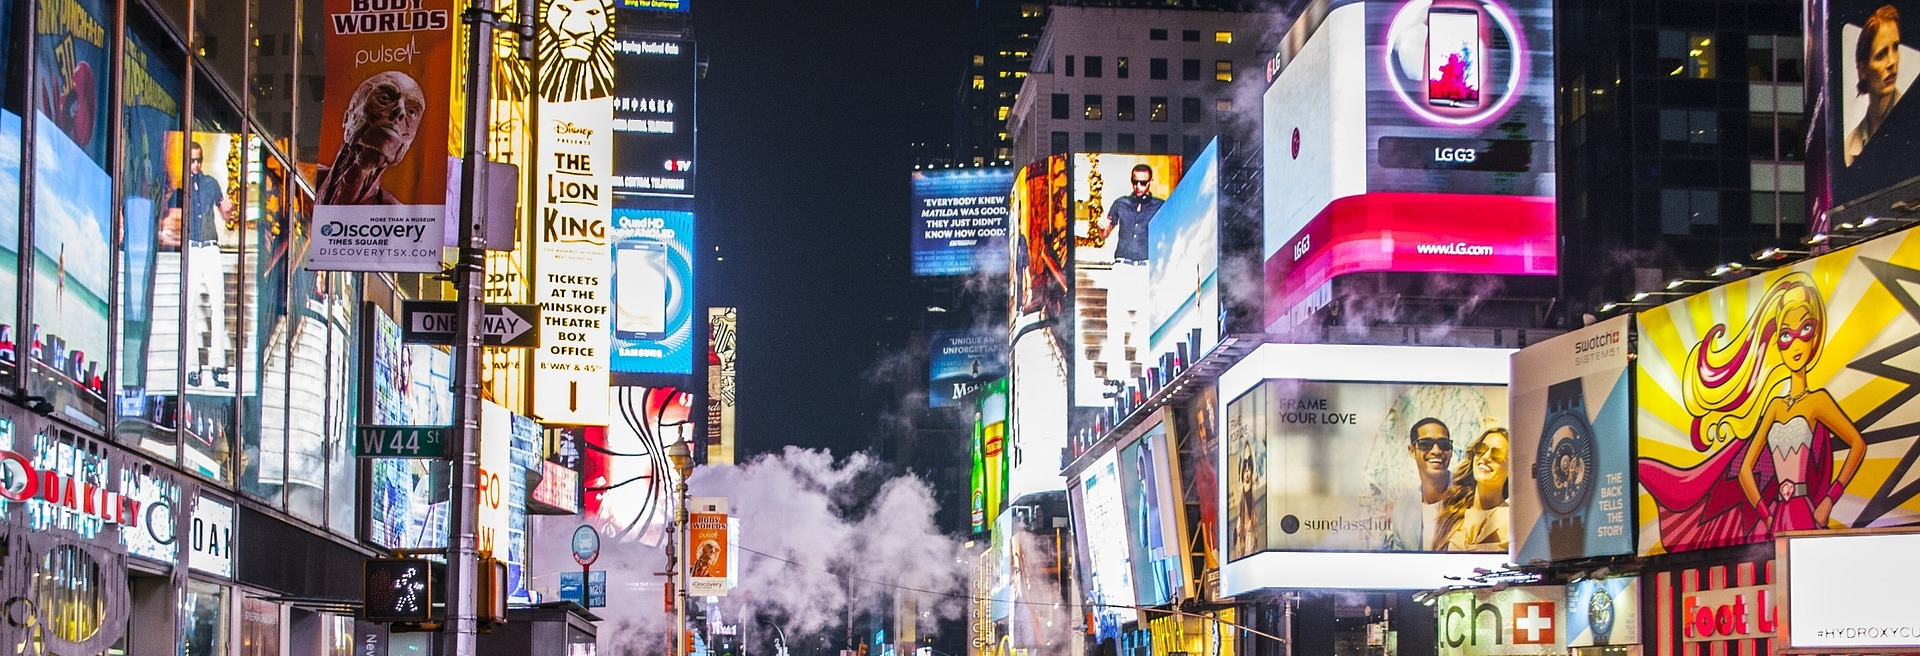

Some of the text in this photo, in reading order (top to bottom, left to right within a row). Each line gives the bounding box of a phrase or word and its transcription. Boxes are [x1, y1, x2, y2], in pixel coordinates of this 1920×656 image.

[351, 0, 422, 12] BODY
[331, 10, 448, 35] WORLDS
[355, 42, 410, 68] pulse
[1272, 52, 1281, 75] LG
[552, 118, 593, 140] Disney
[1434, 147, 1475, 162] LG G3
[554, 152, 591, 171] THE
[548, 174, 599, 204] LION
[978, 196, 1005, 205] KNEW
[921, 207, 1009, 218] MATILDA WAS GOOD,
[543, 207, 605, 243] KING
[926, 218, 1002, 228] THEY JUST DIDN'T
[330, 221, 426, 243] Discovery
[925, 230, 952, 239] KNOW
[954, 229, 976, 238] HOW
[320, 247, 437, 258] DISCOVERYTSX.COM
[1293, 240, 1301, 261] LG
[1416, 242, 1494, 256] www.LG.com
[548, 273, 599, 286] TICKETS
[551, 288, 595, 300] AT THE
[539, 302, 608, 315] MINSKOFF
[422, 314, 520, 334] ONE WAY
[544, 316, 601, 329] THEATRE
[558, 331, 586, 342] BOX
[1575, 332, 1612, 354] swatch
[550, 345, 594, 357] OFFICE
[1575, 347, 1620, 366] SISTEM51
[1279, 399, 1327, 411] FRAME
[1279, 412, 1357, 425] YOUR LOVE
[362, 430, 440, 454] W 44 St
[1606, 472, 1622, 484] THE
[1601, 485, 1623, 498] BACK
[44, 470, 141, 528] OAKLEY
[1599, 499, 1623, 511] TELLS
[1607, 512, 1623, 523] THE
[1304, 516, 1393, 535] sunglass hut
[1597, 525, 1624, 537] STORY
[1684, 594, 1749, 638] Foot
